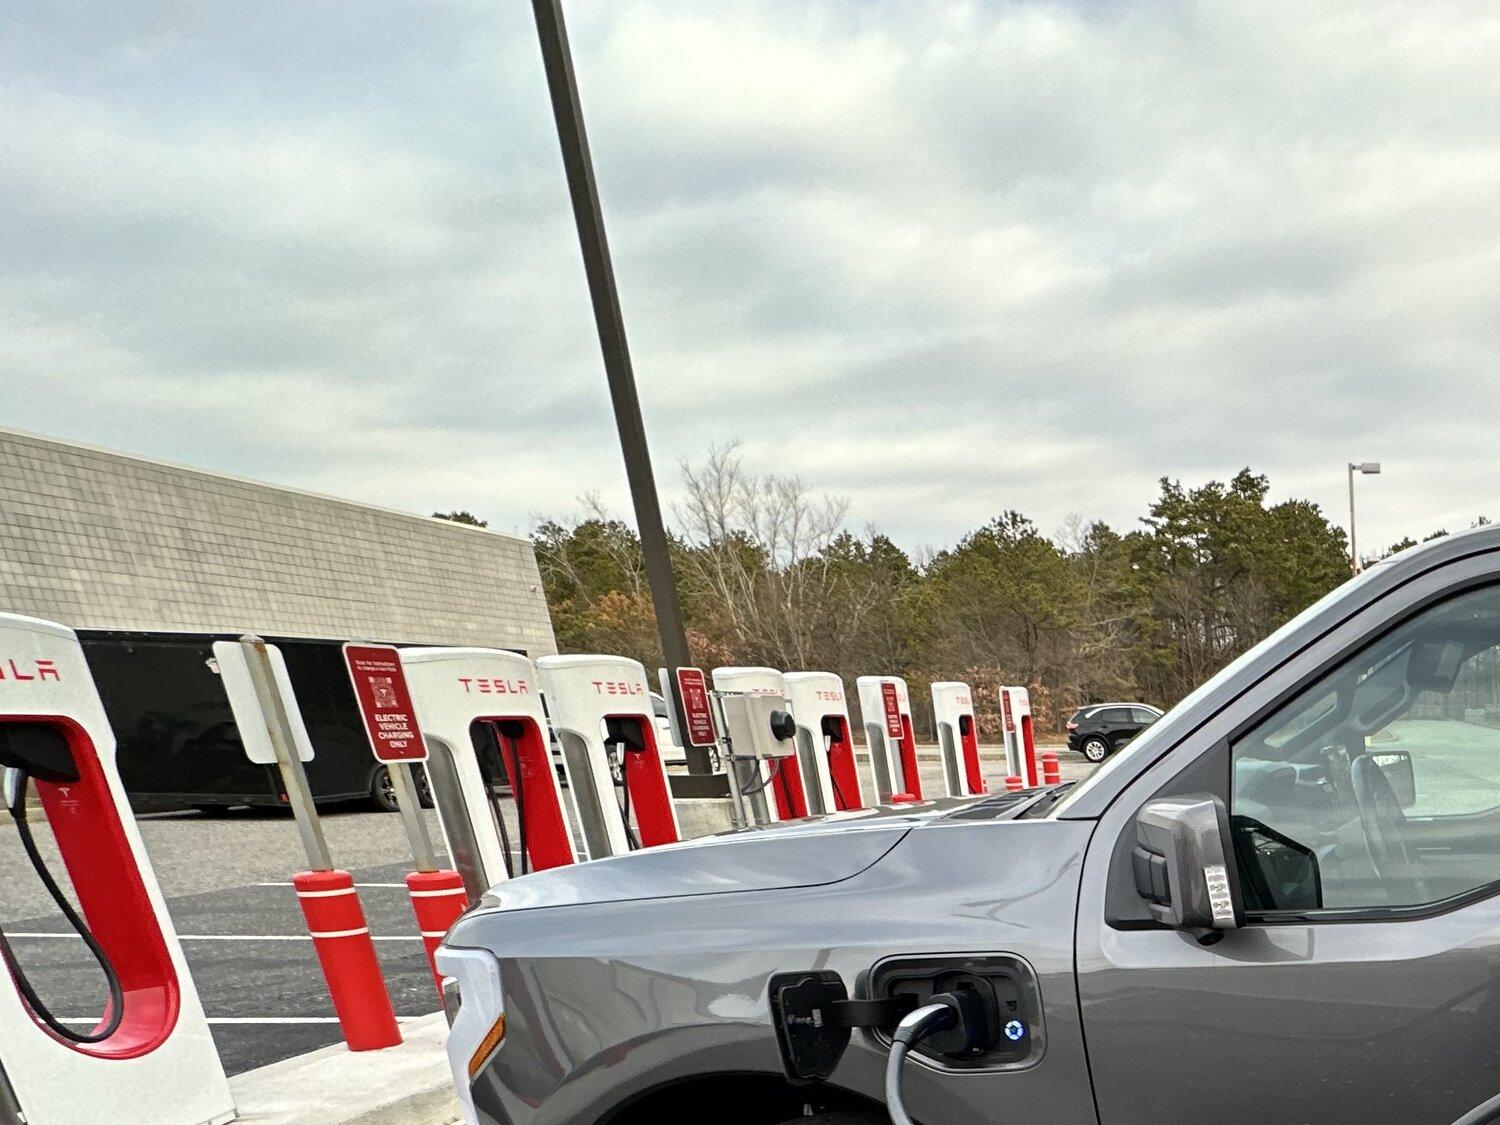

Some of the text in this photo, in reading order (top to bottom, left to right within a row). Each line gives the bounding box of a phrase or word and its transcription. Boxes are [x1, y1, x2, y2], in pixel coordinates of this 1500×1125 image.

[0, 658, 61, 681] LA
[458, 678, 529, 694] TESLA
[592, 681, 644, 695] TESLA
[378, 722, 408, 730] VEHICLE
